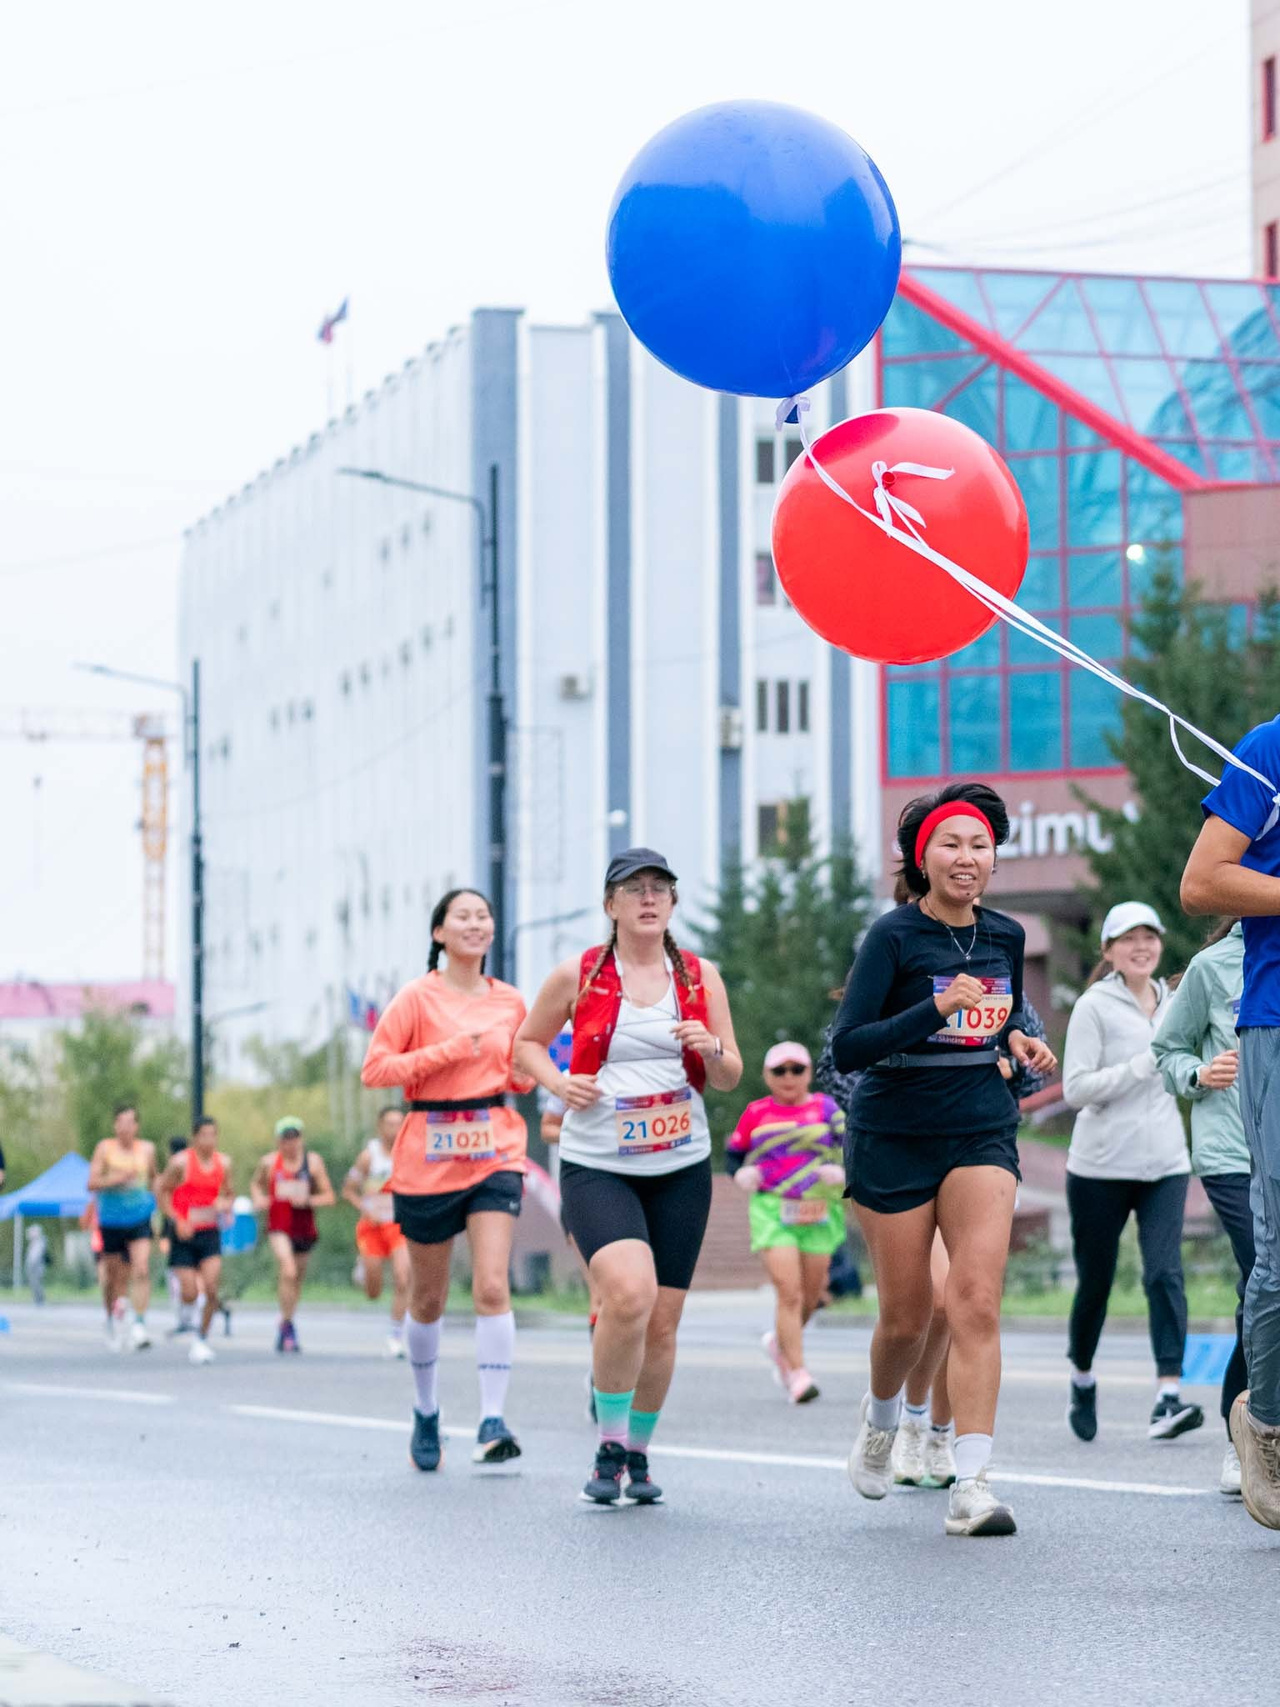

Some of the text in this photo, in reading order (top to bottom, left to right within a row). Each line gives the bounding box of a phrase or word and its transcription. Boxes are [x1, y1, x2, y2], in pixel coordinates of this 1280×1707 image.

[996, 801, 1141, 858] zimu
[946, 1006, 1008, 1029] 1039
[622, 1111, 690, 1140] 21026
[433, 1131, 489, 1149] 21021
